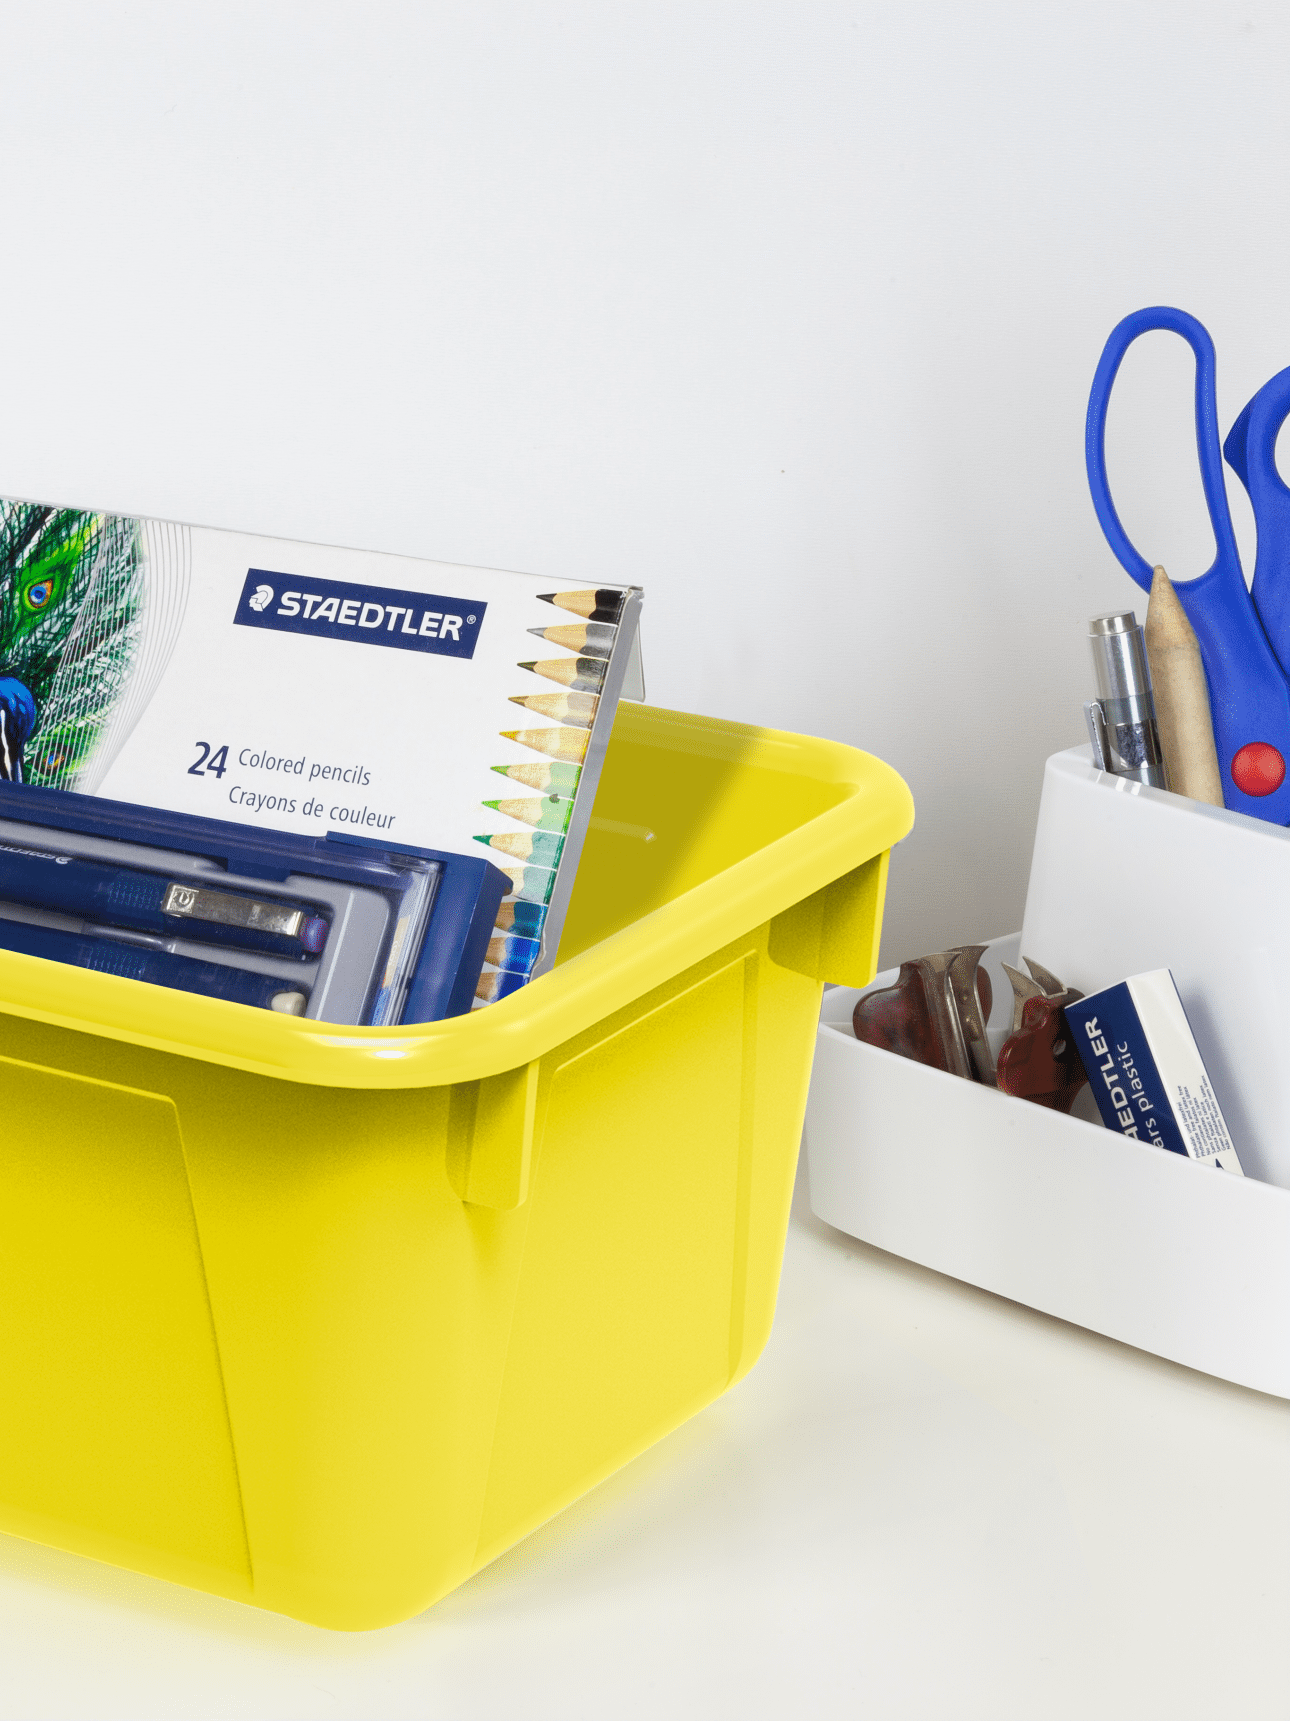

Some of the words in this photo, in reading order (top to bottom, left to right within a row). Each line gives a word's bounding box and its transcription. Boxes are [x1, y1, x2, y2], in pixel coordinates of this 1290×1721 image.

[187, 741, 230, 779] 24
[238, 748, 306, 775] Colored
[308, 762, 372, 786] pencils
[229, 786, 297, 813] Crayons
[302, 797, 324, 818] de
[329, 806, 396, 830] couleur
[1116, 1041, 1154, 1112] plastic
